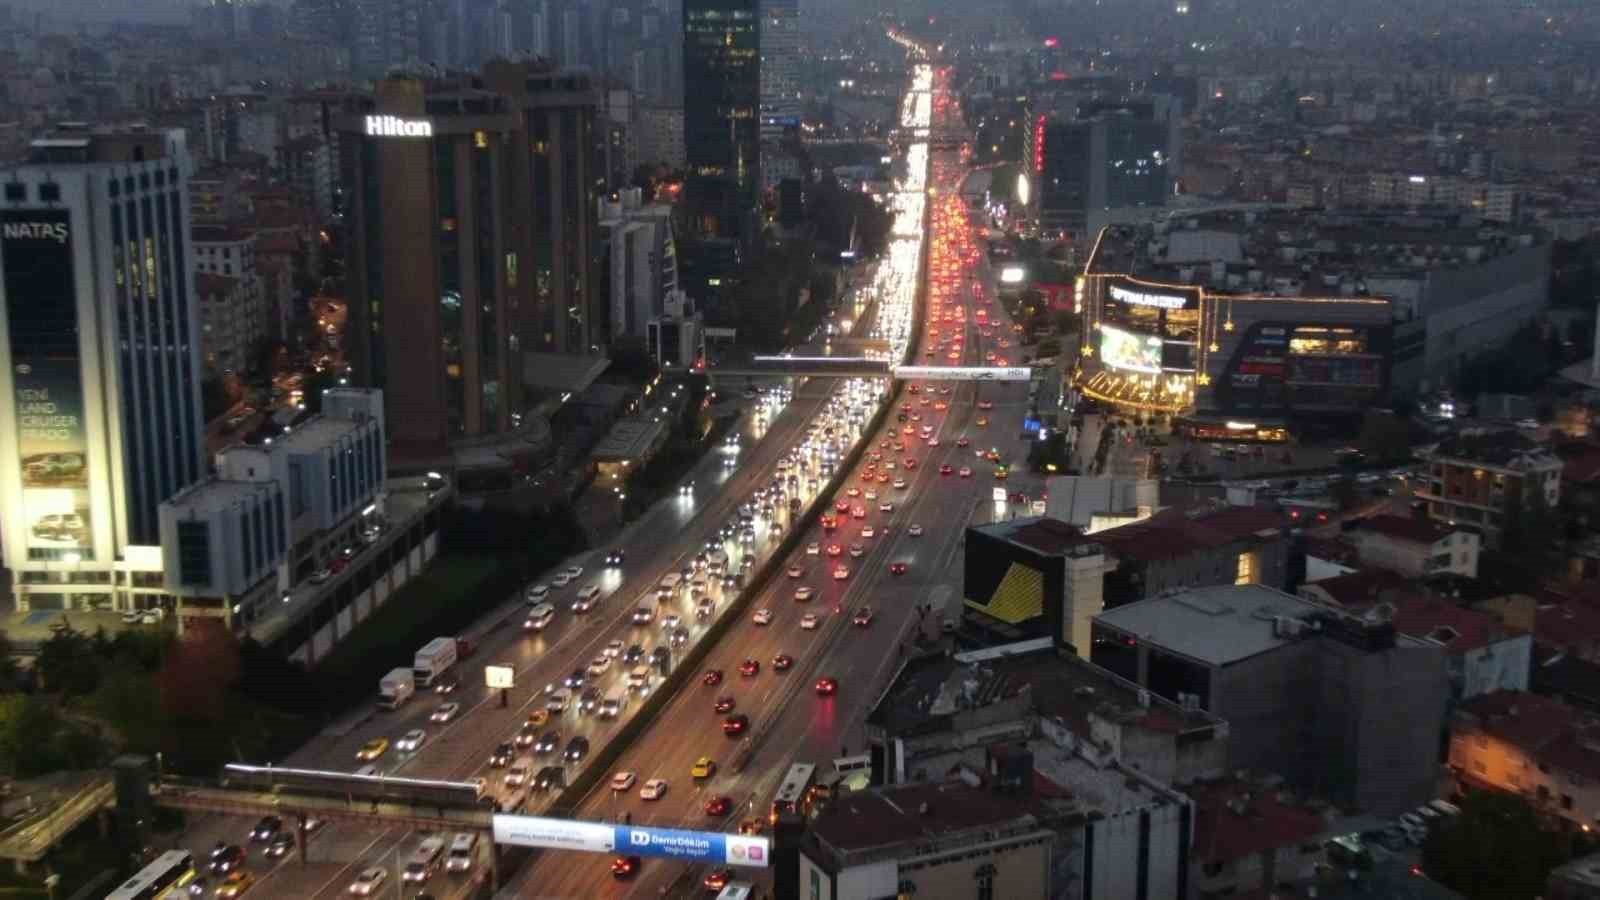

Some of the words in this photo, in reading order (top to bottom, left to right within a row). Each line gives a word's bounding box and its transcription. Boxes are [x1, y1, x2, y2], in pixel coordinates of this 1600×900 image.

[366, 114, 432, 137] Hilton
[4, 222, 68, 243] NATAŞ
[20, 402, 57, 414] LAND
[21, 415, 78, 427] CRUISER
